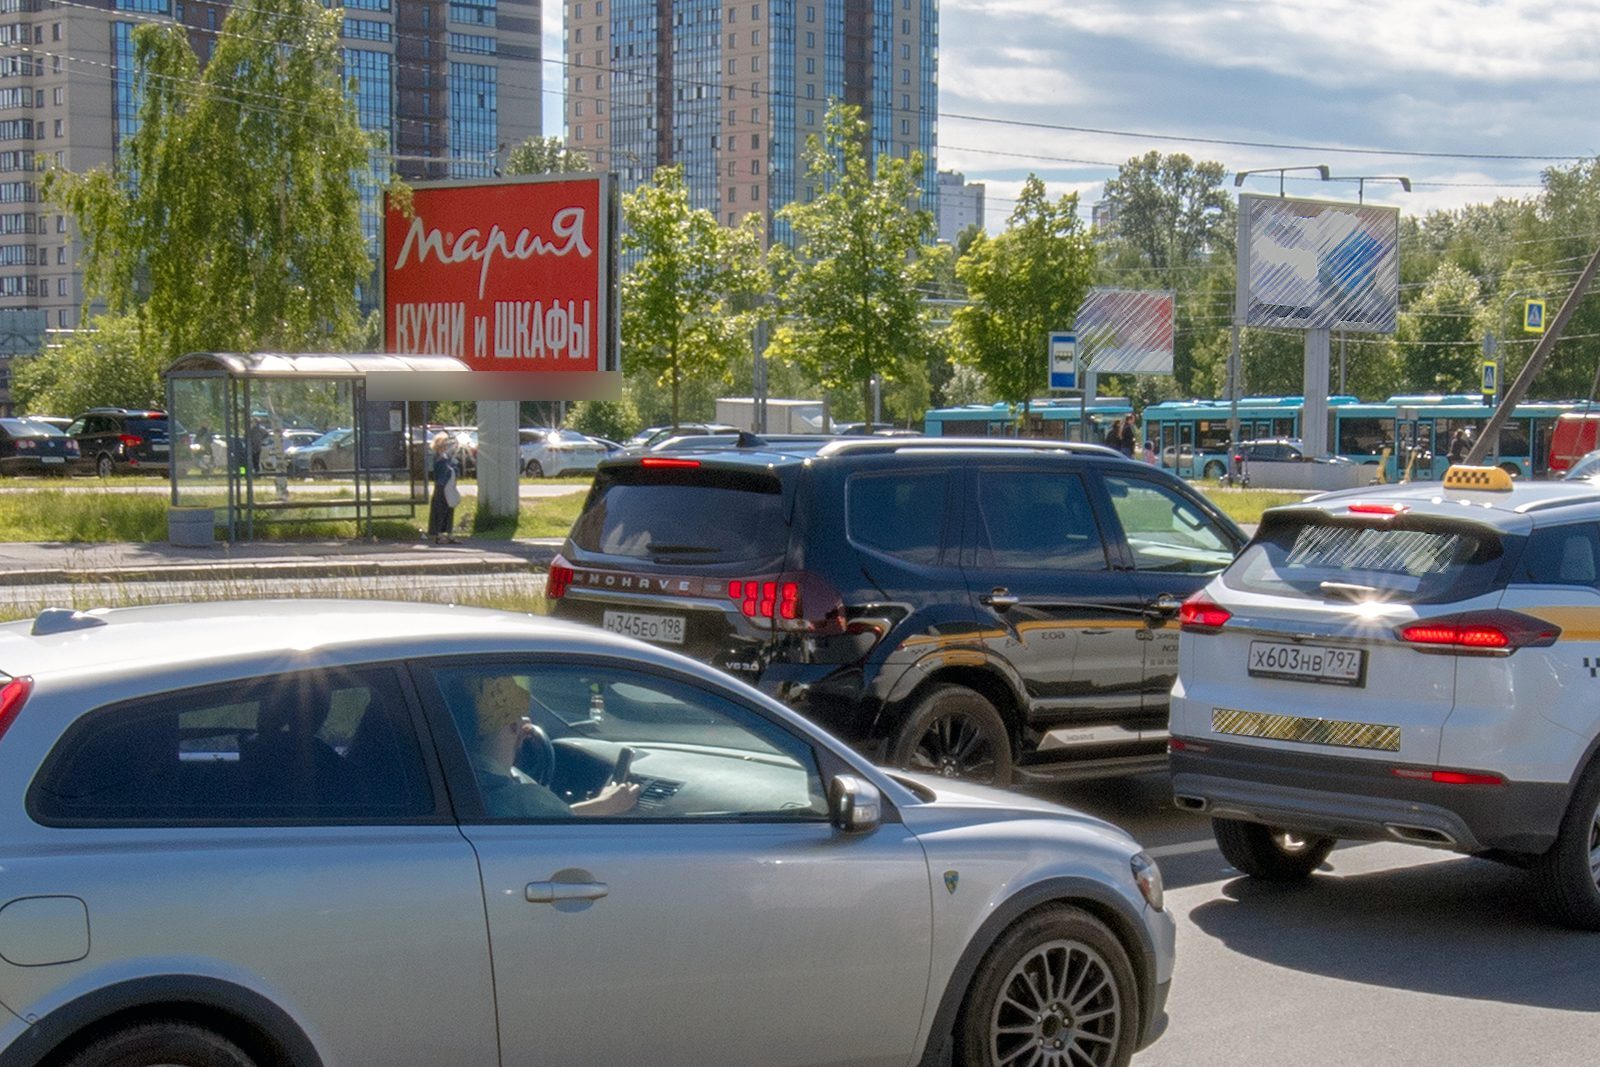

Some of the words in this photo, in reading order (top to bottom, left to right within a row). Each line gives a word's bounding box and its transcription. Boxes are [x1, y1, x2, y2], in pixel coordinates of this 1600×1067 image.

[396, 302, 466, 358] КУХНИ
[474, 316, 487, 358] и
[494, 299, 590, 359] ШКАФЫ
[661, 618, 681, 634] 198
[1254, 646, 1323, 672] Х603НВ
[1327, 650, 1356, 669] 797
